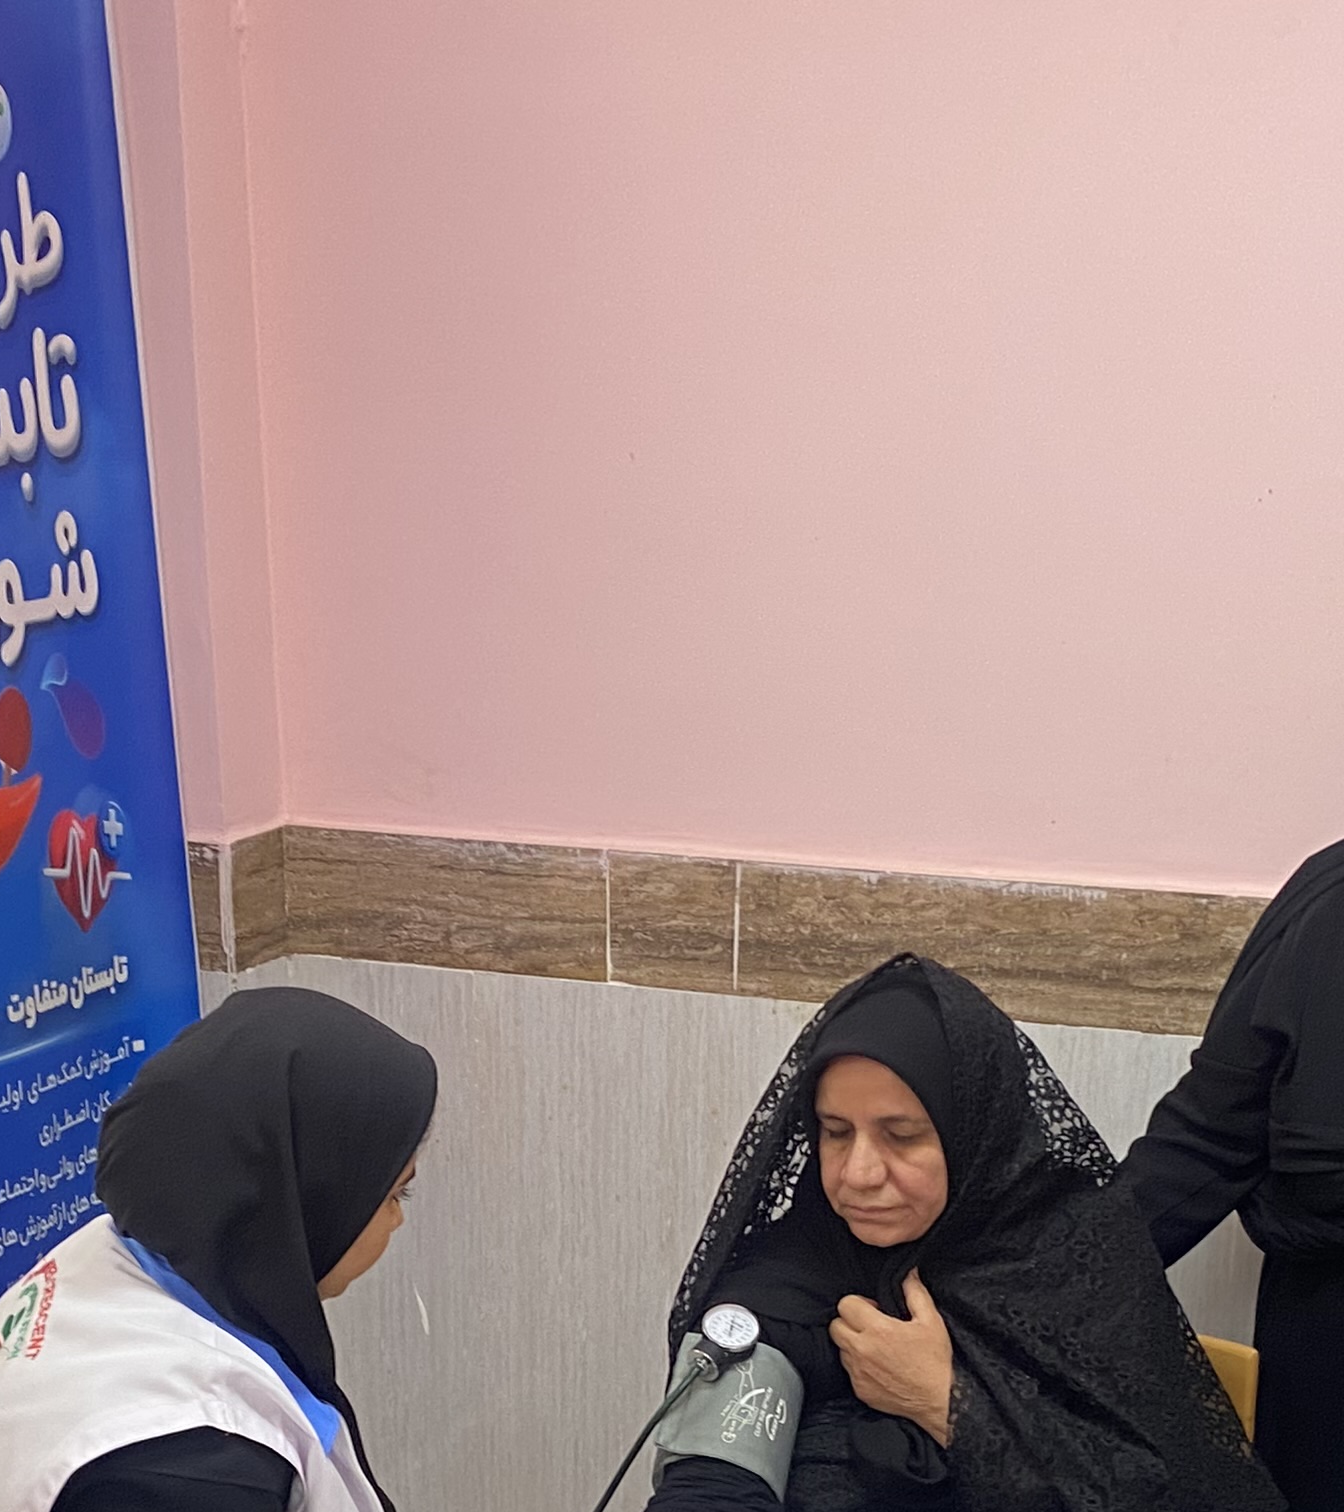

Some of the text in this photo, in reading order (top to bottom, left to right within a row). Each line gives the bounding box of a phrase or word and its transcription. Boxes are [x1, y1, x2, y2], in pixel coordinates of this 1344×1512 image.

[6, 955, 129, 1029] تابستان متفاوت
[83, 1035, 131, 1080] آموزش
[38, 1098, 90, 1147] اضطراری
